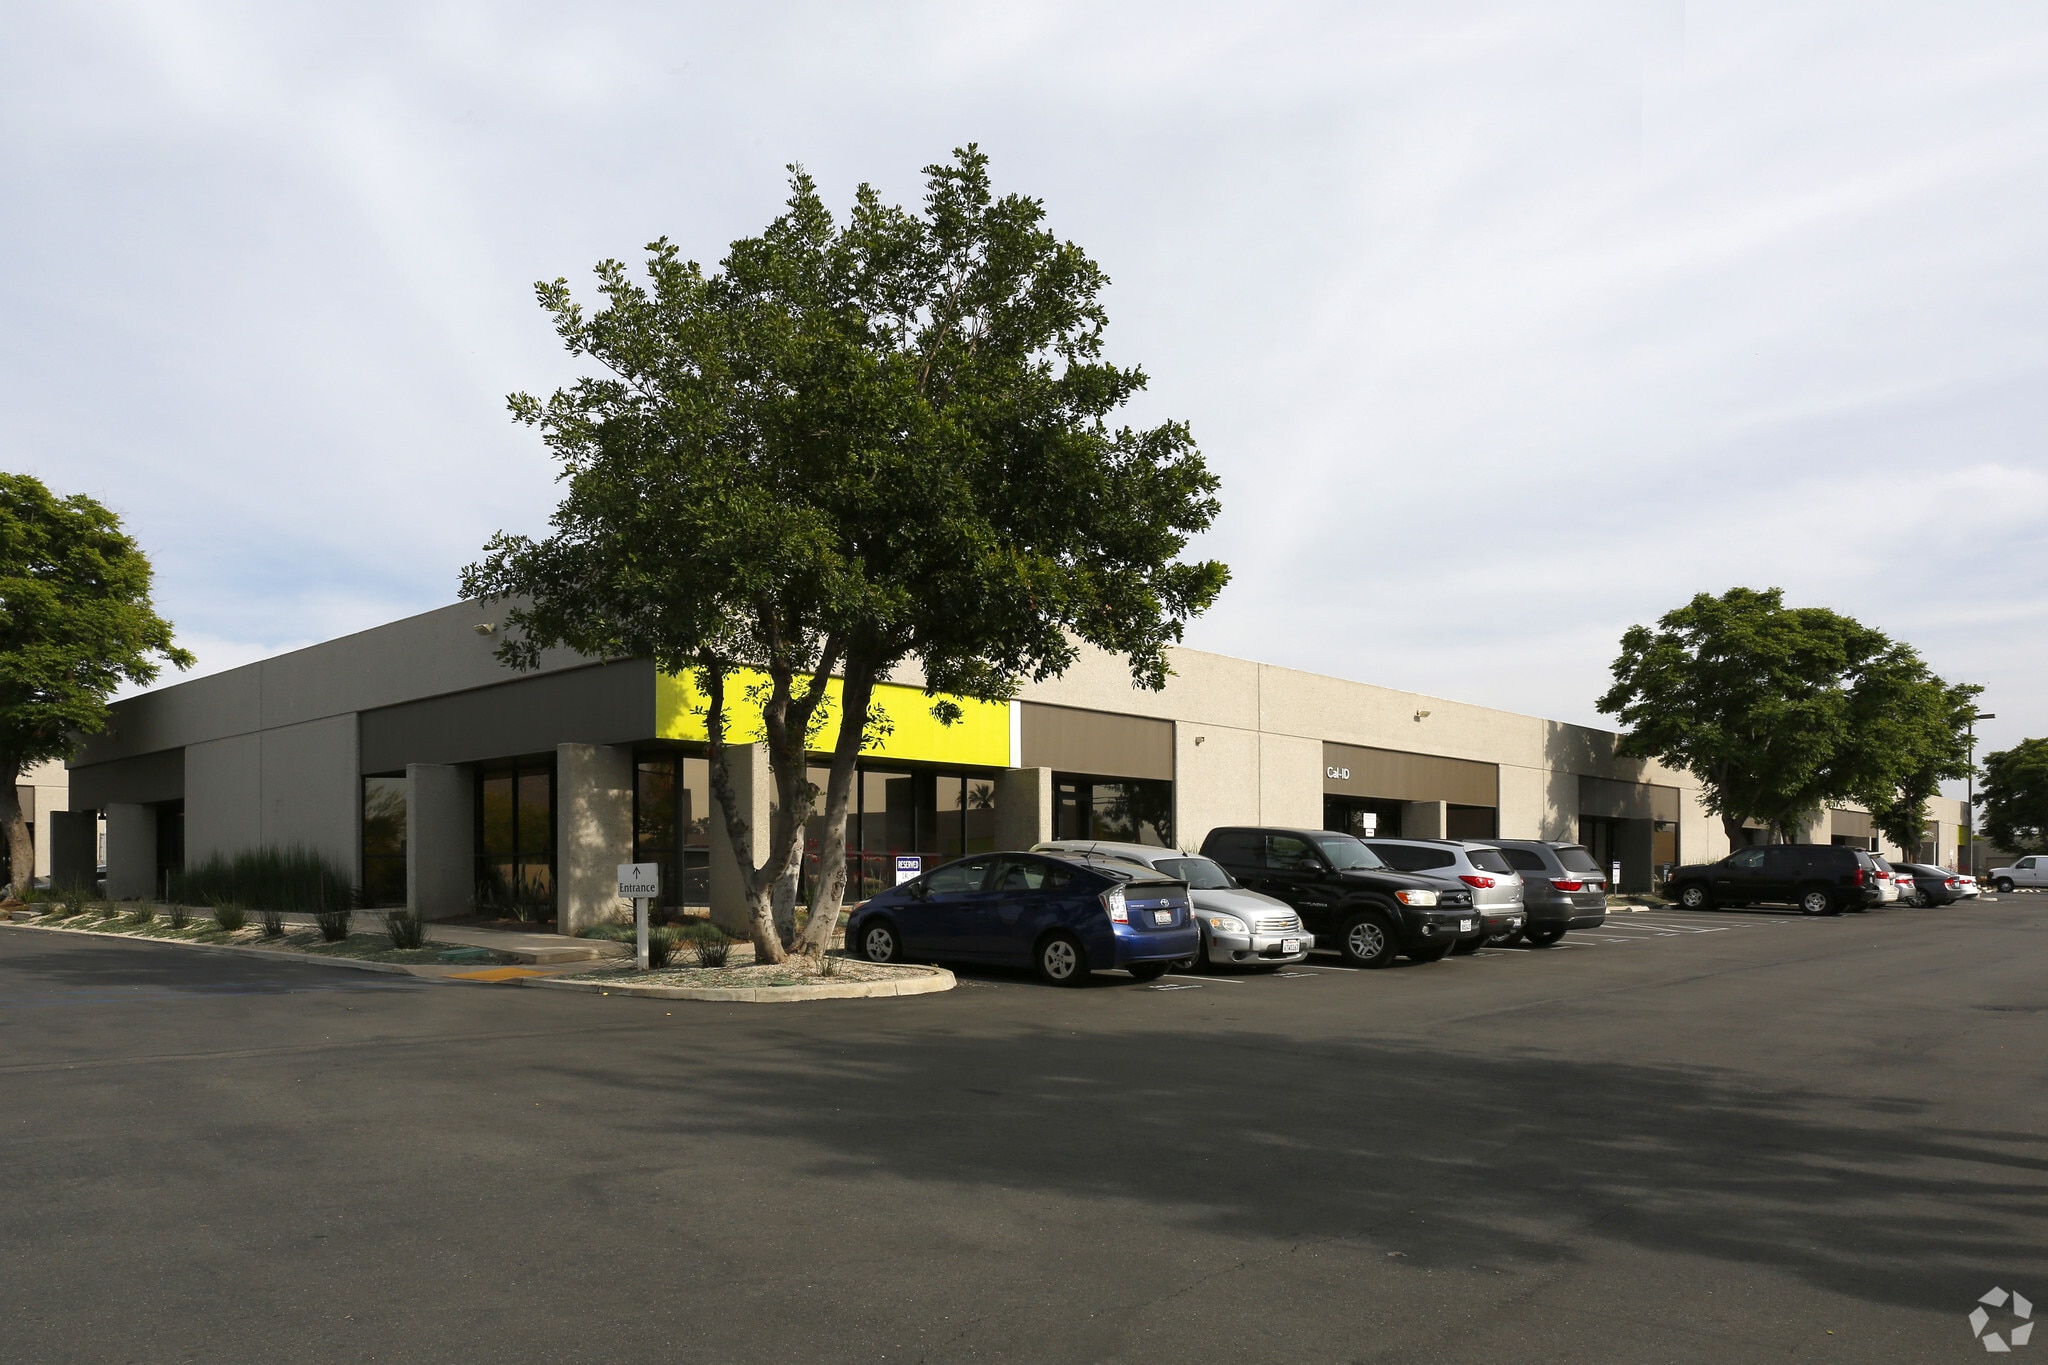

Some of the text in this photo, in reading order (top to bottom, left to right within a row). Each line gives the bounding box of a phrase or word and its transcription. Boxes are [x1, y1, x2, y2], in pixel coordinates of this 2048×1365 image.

[1327, 766, 1350, 780] Cal-ID
[897, 861, 919, 869] RESERVED
[619, 882, 656, 893] Entrance
